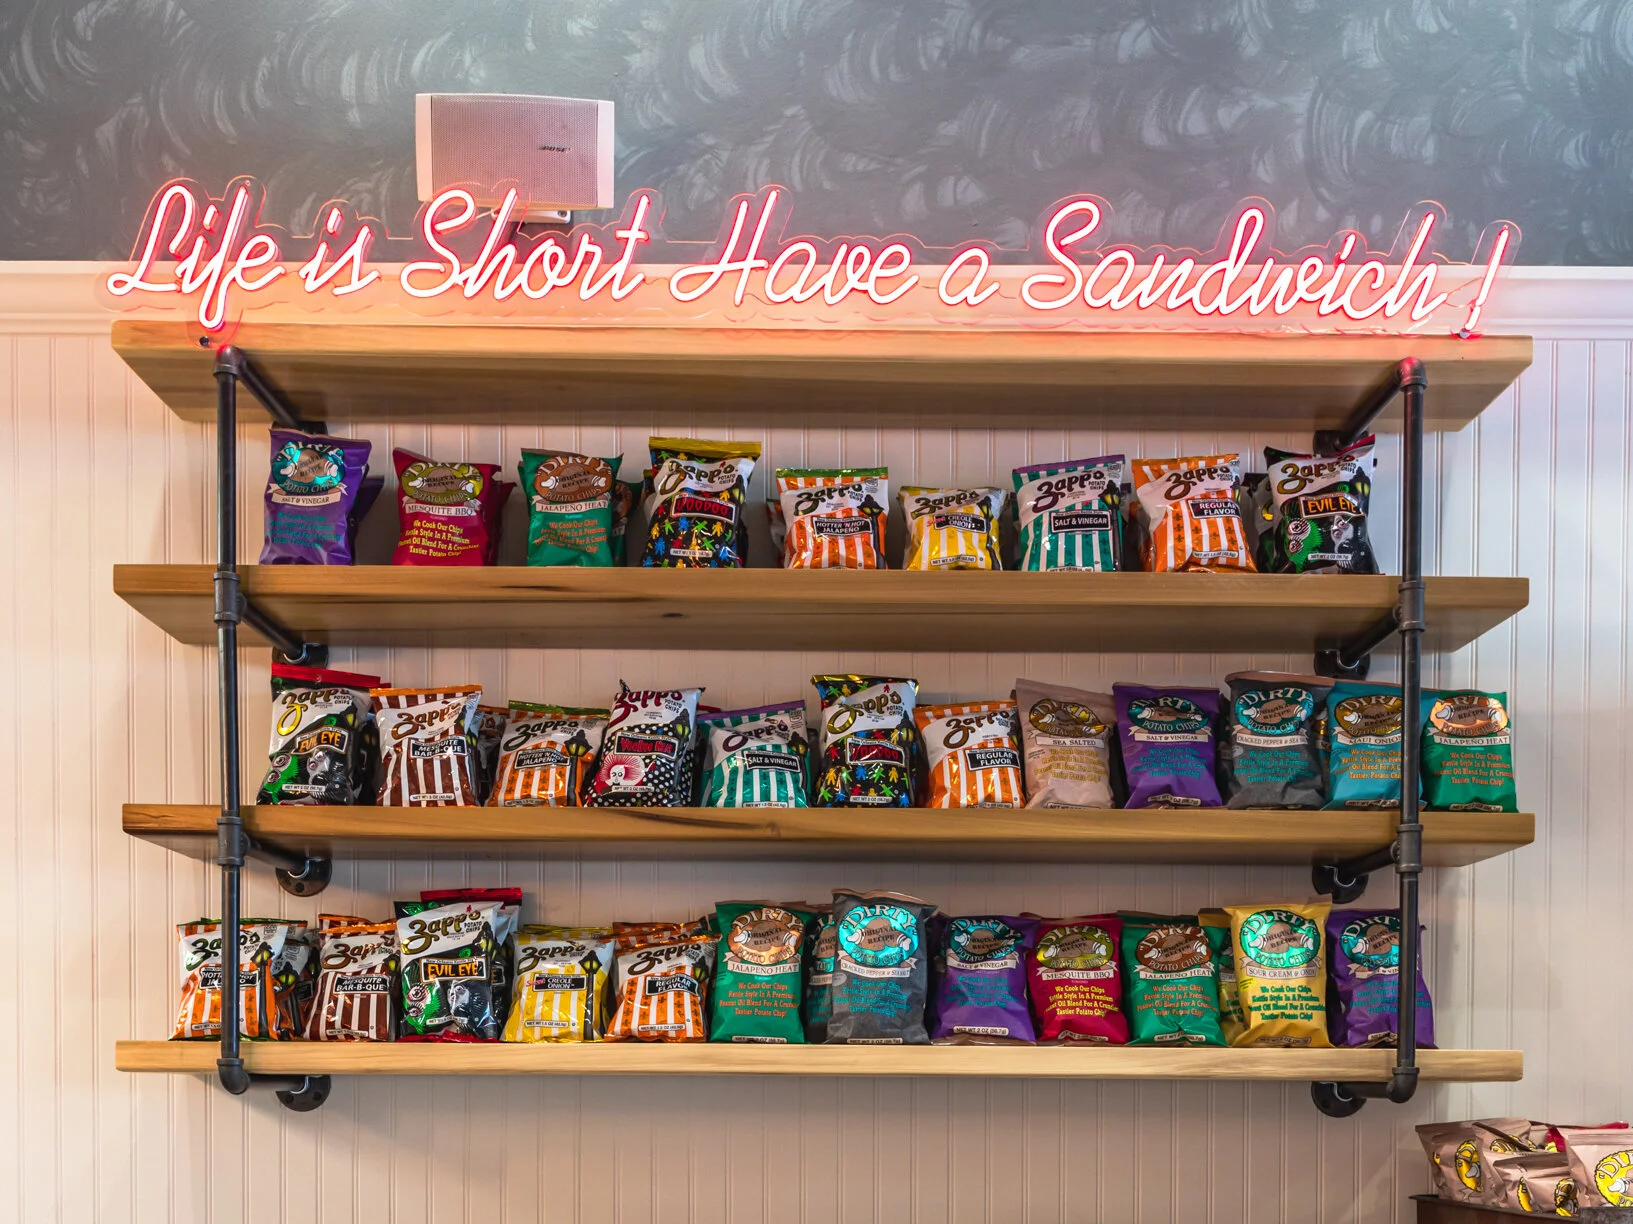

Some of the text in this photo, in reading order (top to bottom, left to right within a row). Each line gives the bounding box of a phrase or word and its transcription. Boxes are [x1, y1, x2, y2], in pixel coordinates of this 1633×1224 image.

[105, 183, 286, 328] Life
[300, 206, 381, 296] is
[400, 186, 648, 301] Short
[668, 186, 919, 305] Have
[938, 246, 1000, 305] a
[302, 496, 330, 504] VINEGAR
[408, 506, 473, 516] MESQUITE BBQ
[677, 498, 728, 516] VOODOO
[1308, 499, 1336, 513] EVIL
[422, 520, 436, 529] Cook
[664, 699, 682, 707] POTATO
[665, 704, 679, 713] CHIPS
[1142, 720, 1199, 731] POTATO CHIPS
[1248, 719, 1277, 732] POTATO
[321, 732, 340, 746] EYE
[976, 752, 1013, 760] REGULAR
[770, 757, 797, 767] VINEGAR
[981, 758, 1012, 766] FLAVOR
[868, 934, 895, 944] RECIPE
[956, 947, 984, 962] POTATO
[1149, 955, 1204, 971] POTATO CHIPS
[428, 962, 479, 980] EVIL EYE
[775, 965, 798, 973] HEAT
[841, 963, 865, 974] CRACKED
[1249, 968, 1267, 976] SOUR
[656, 979, 691, 988] REGULAR
[1091, 986, 1105, 994] Chips
